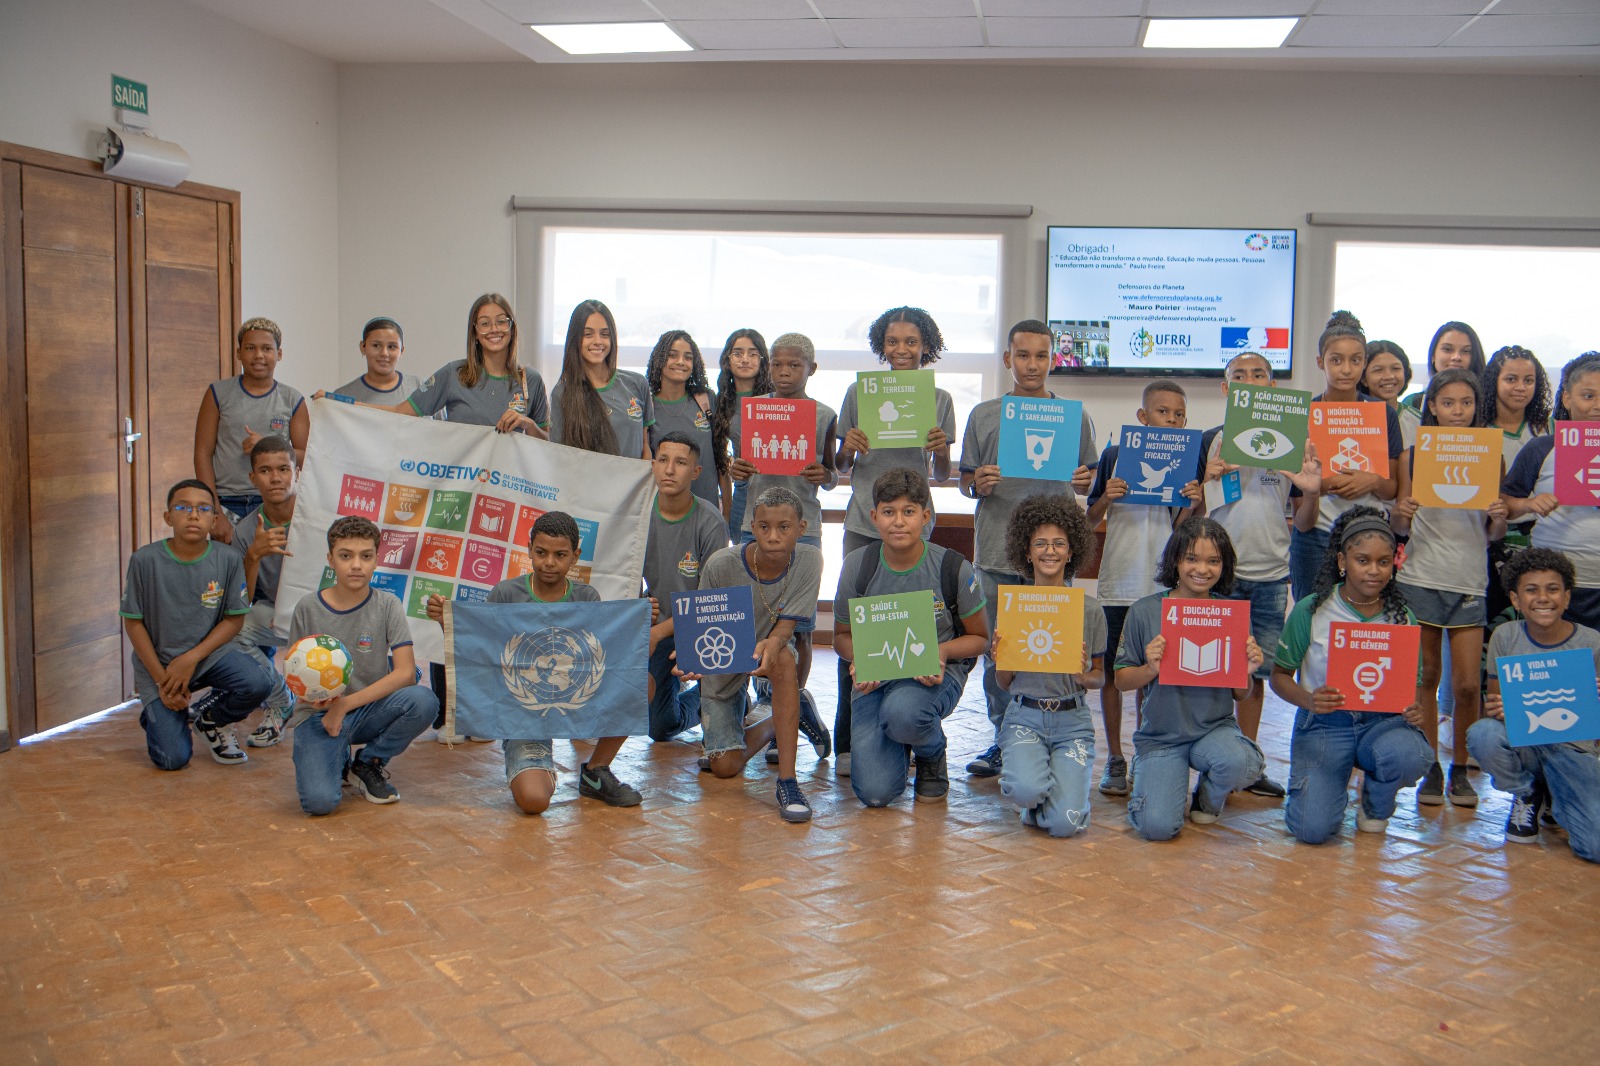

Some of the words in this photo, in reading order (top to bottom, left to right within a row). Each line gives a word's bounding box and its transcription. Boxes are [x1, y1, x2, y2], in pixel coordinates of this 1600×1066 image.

[115, 84, 146, 110] SAÍDA
[1068, 244, 1109, 254] Obrigado
[1156, 334, 1191, 347] UFRRJ
[882, 376, 896, 384] VIDA
[861, 377, 877, 394] 15
[883, 385, 915, 393] TERRESTRE
[1233, 389, 1250, 408] 13
[1254, 391, 1271, 401] AÇÃO
[1272, 394, 1297, 404] CONTRA
[1298, 397, 1303, 405] A
[745, 403, 752, 420] 1
[756, 403, 795, 413] ERRADICAÇÃO
[1005, 402, 1015, 419] 6
[1020, 402, 1037, 411] ÁGUA
[1039, 404, 1064, 413] POTÁVEL
[1253, 402, 1283, 413] MUDANÇA
[1284, 406, 1308, 415] GLOBAL
[1327, 407, 1361, 416] INDÚSTRIA,
[765, 413, 790, 421] POBREZA
[1025, 413, 1064, 423] SANEAMENTO
[1262, 413, 1281, 422] CLIMA
[1313, 408, 1322, 425] 9
[1327, 417, 1358, 426] INOVAÇÃO
[1328, 427, 1380, 435] INFRAESTRUTURA
[1585, 428, 1600, 436] RED
[1126, 432, 1142, 448] 16
[1147, 432, 1160, 441] PAZ,
[1161, 433, 1184, 443] JUSTIÇA
[1420, 433, 1431, 451] 2
[1437, 434, 1455, 442] FOME
[1456, 434, 1474, 442] ZERO
[1560, 428, 1579, 446] 10
[1145, 442, 1185, 452] INSTITUIÇÕES
[1442, 444, 1488, 453] AGRICULTURA
[1144, 451, 1171, 460] EFICAZES
[1435, 453, 1480, 463] SUSTENTÁVEL
[416, 461, 501, 485] OBJETIVOS
[347, 478, 351, 488] 1
[511, 475, 560, 493] DESENVOLVIMENTO
[392, 486, 397, 496] 2
[436, 493, 442, 502] 3
[478, 497, 484, 507] 4
[522, 509, 528, 518] 5
[382, 532, 388, 541] 8
[426, 536, 431, 545] 9
[469, 543, 477, 552] 10
[325, 569, 334, 579] 13
[415, 580, 423, 590] 15
[460, 588, 467, 597] 16
[1018, 593, 1046, 601] ENERGIA
[1049, 594, 1069, 602] LIMPA
[695, 594, 728, 603] PARCERIAS
[1004, 592, 1012, 611] 7
[676, 597, 690, 615] 17
[700, 605, 719, 613] MEIOS
[721, 604, 728, 612] DE
[870, 601, 892, 611] SAÚDE
[1024, 603, 1059, 613] ACESSÍVEL
[1183, 605, 1220, 617] EDUCAÇÃO
[1222, 608, 1231, 616] DE
[697, 611, 745, 623] IMPLEMENTAÇÃO
[855, 605, 865, 624] 3
[871, 611, 908, 622] BEM-ESTAR
[1167, 605, 1178, 624] 4
[1182, 617, 1221, 627] QUALIDADE
[1334, 629, 1345, 648] 5
[1351, 629, 1390, 639] IGUALDADE
[1350, 641, 1360, 649] DE
[1361, 640, 1388, 650] GÊNERO
[1527, 660, 1546, 669] VIDA
[1547, 659, 1558, 667] NA
[1502, 662, 1524, 682] 14
[1529, 670, 1550, 681] ÁGUA
